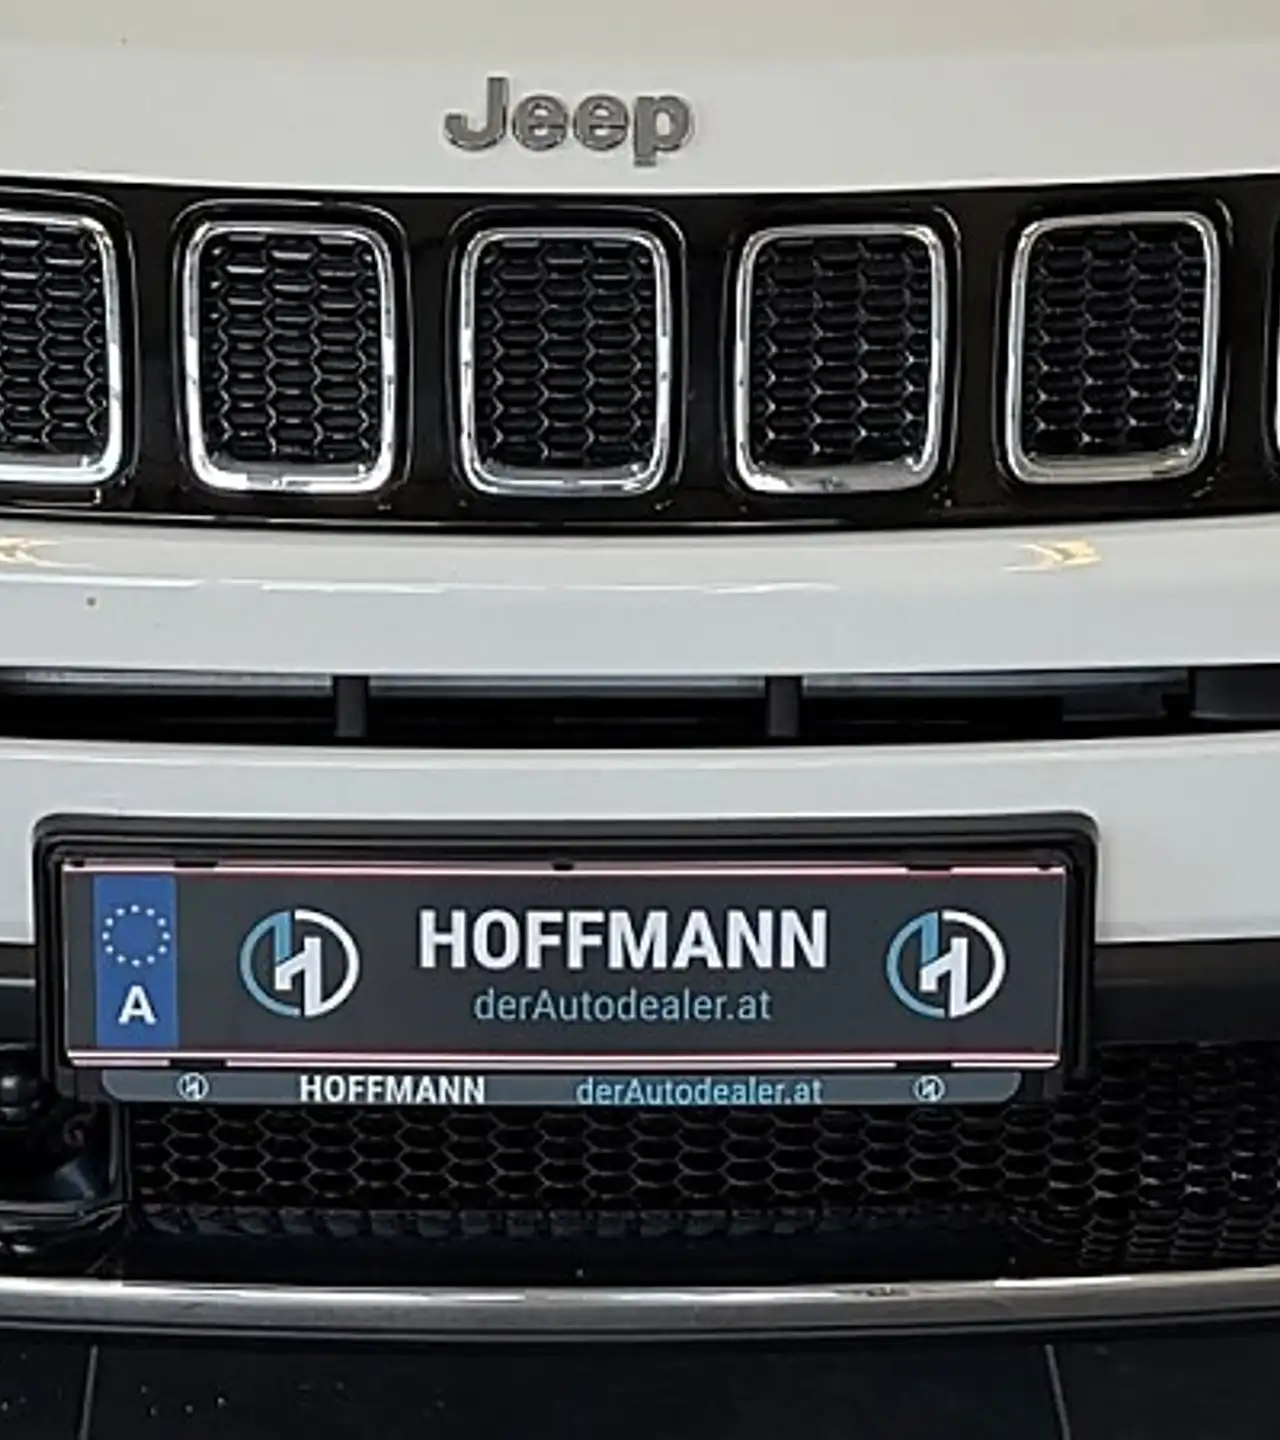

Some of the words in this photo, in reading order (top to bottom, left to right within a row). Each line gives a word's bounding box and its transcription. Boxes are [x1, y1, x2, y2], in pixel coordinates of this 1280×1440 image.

[444, 75, 693, 167] Jeep
[420, 908, 828, 970] HOFFMANN
[118, 985, 157, 1025] A
[473, 987, 773, 1021] derAutodealer.at
[299, 1074, 487, 1104] HOFFMANN
[576, 1075, 823, 1105] derAutodealer.at
